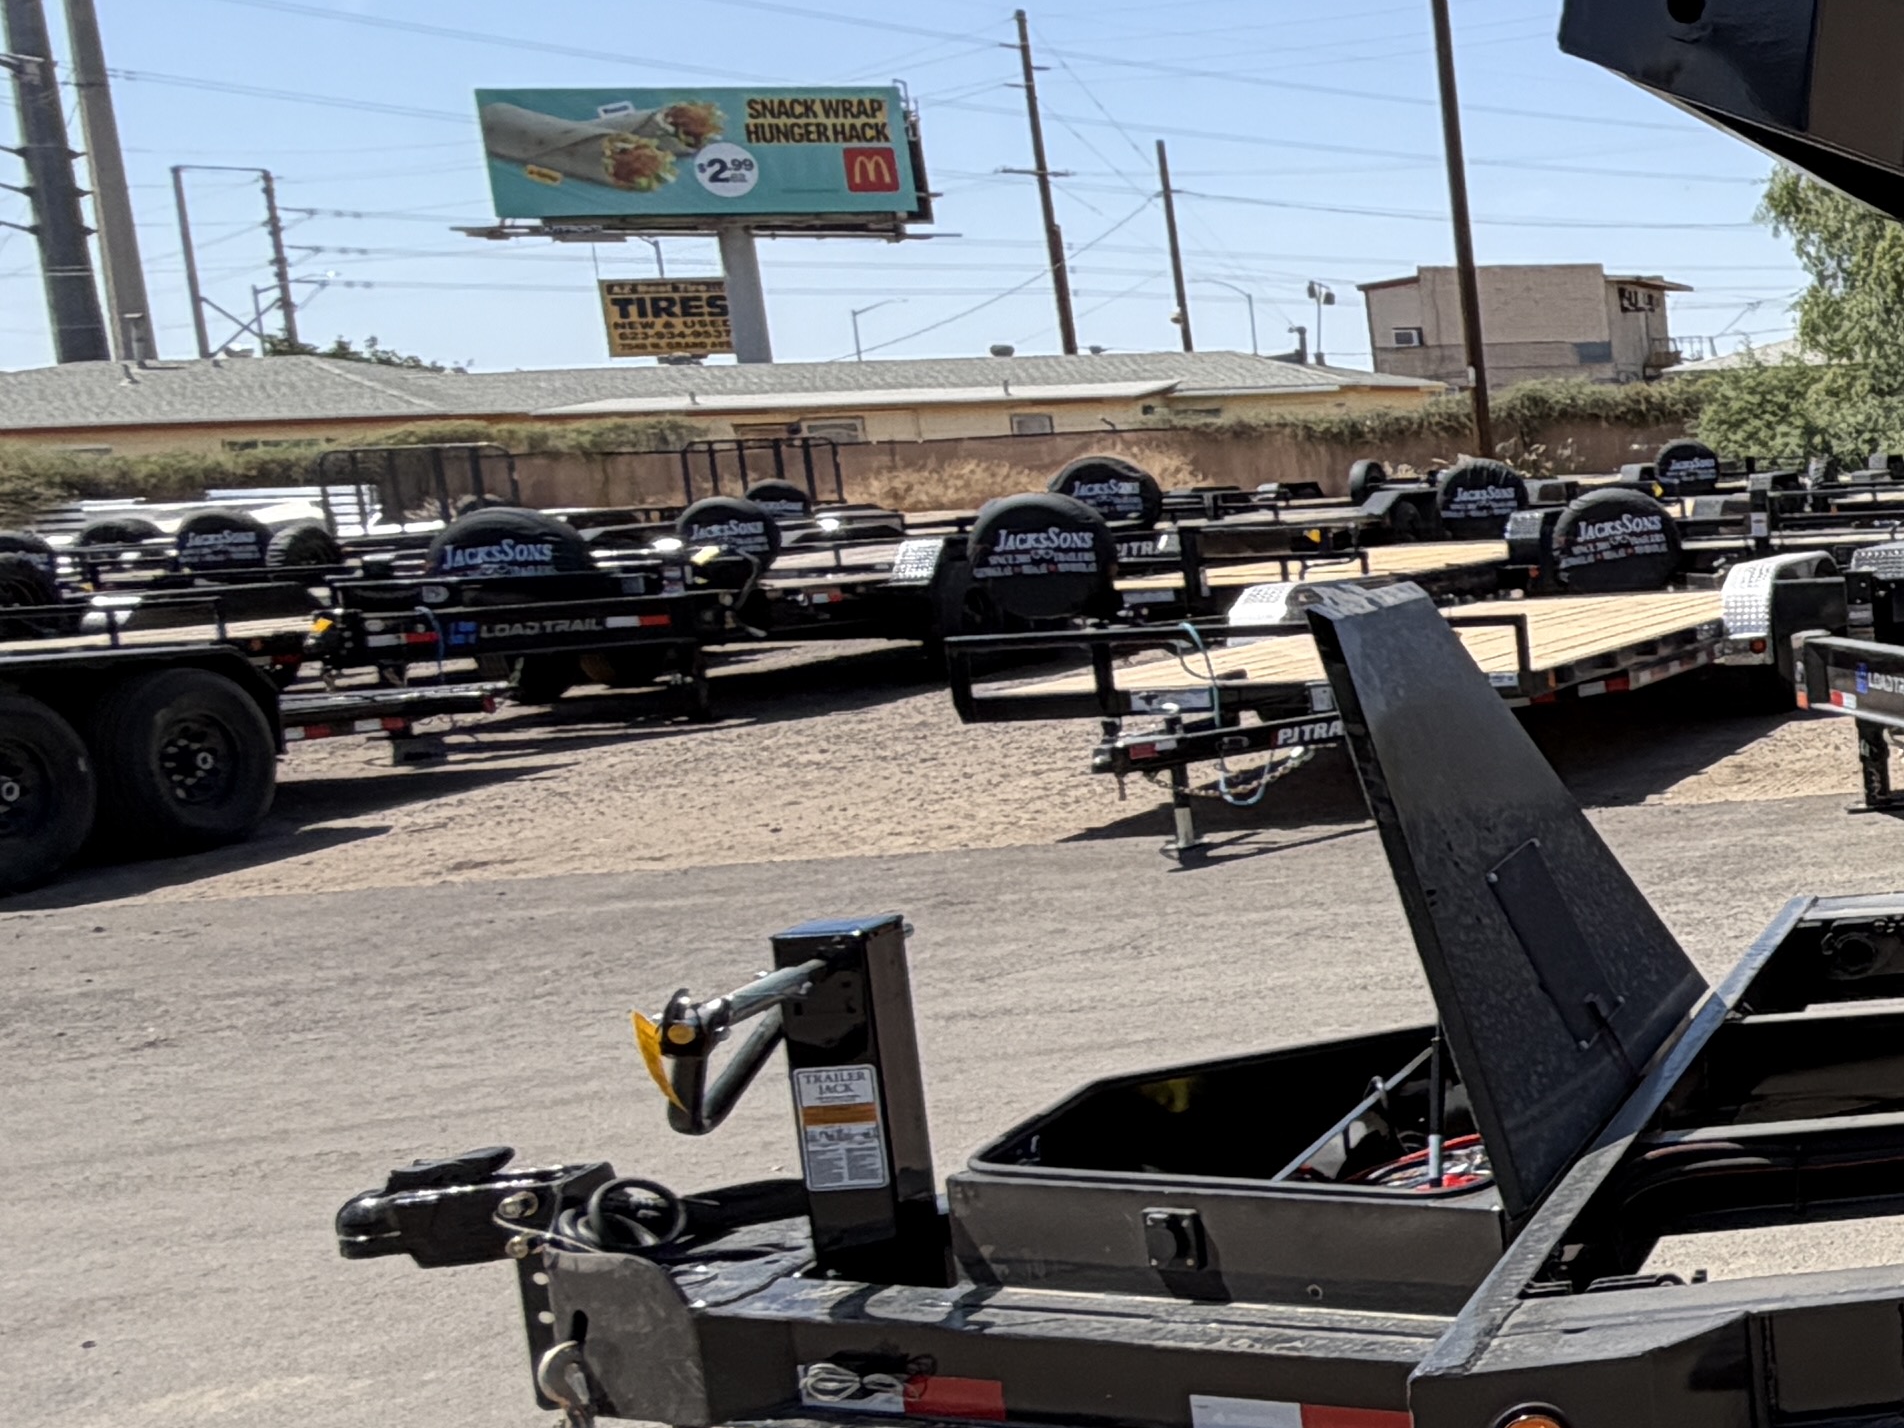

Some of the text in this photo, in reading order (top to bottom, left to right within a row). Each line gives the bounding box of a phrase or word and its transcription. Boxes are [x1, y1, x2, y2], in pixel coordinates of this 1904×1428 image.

[746, 98, 883, 121] SNACK WRAP
[745, 122, 891, 144] HUNGER HACK
[610, 294, 730, 320] TIRES
[613, 321, 656, 331] NEW
[480, 618, 603, 638] LOAD TRAIL
[1277, 727, 1302, 746] PJ
[802, 1071, 866, 1085] TRAILER
[818, 1083, 855, 1096] JACK
